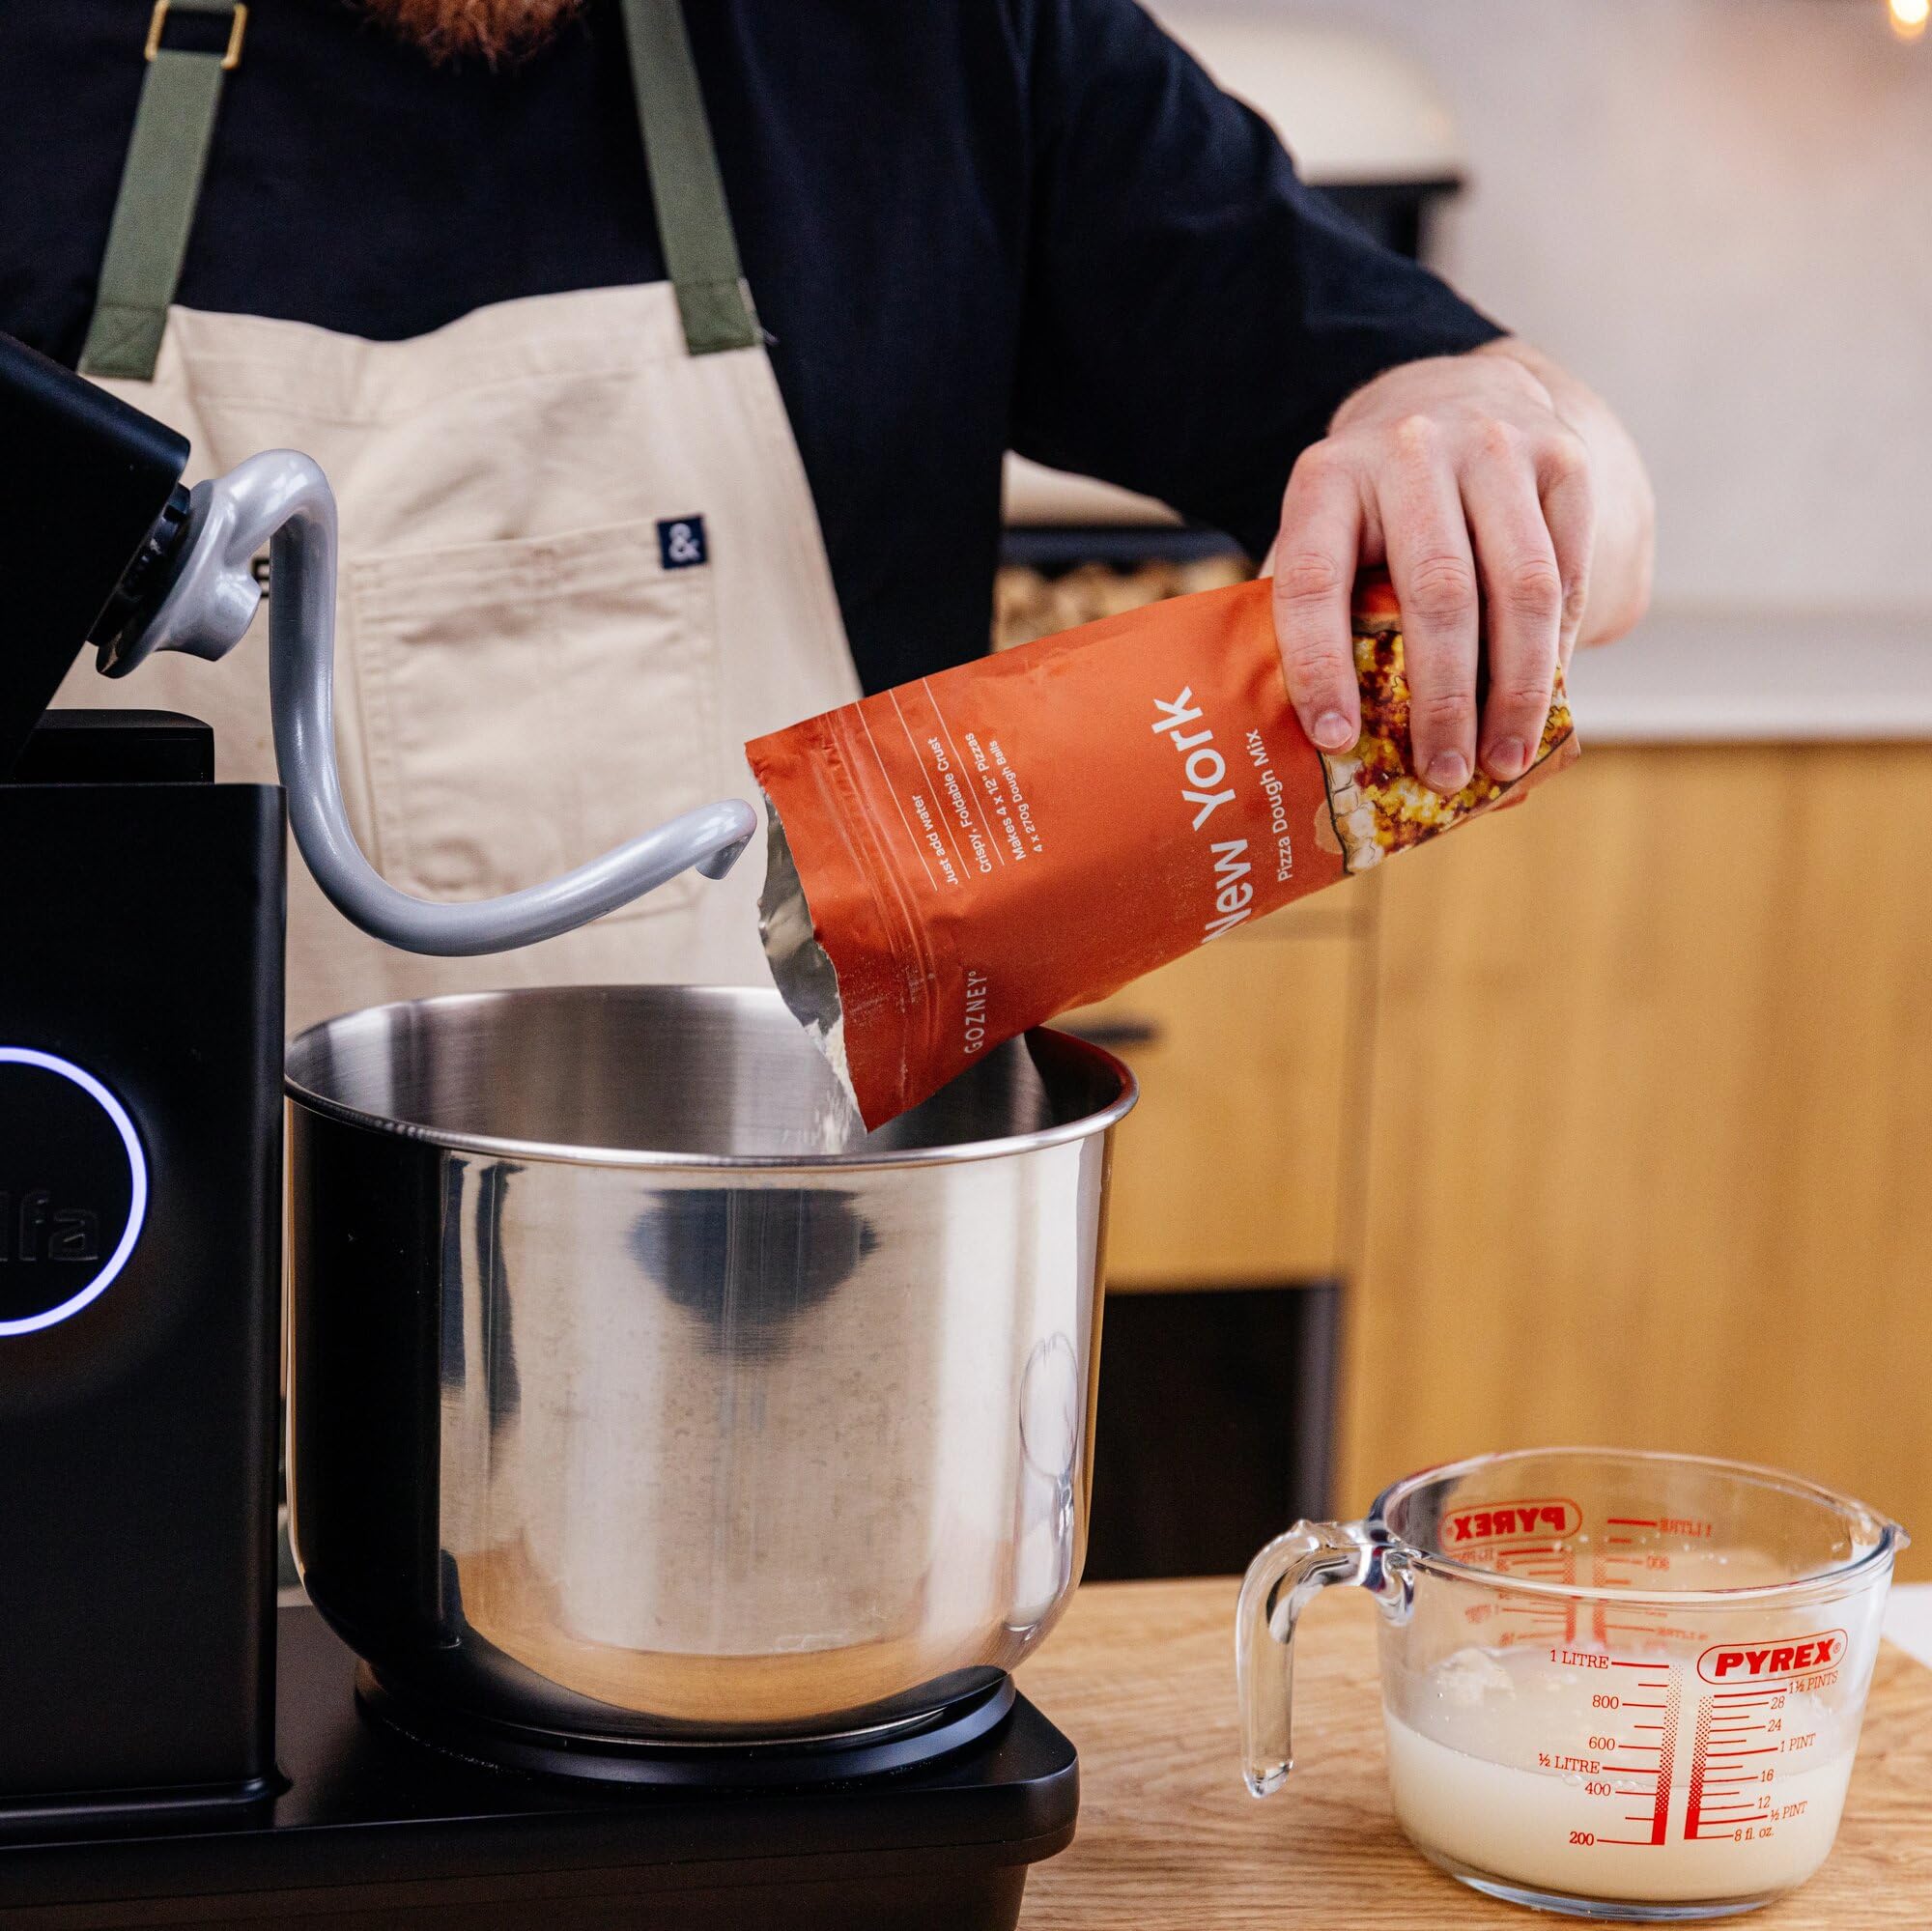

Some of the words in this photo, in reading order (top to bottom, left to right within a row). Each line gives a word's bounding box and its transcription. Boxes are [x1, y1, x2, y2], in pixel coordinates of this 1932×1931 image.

[927, 736, 950, 772] Crust
[965, 732, 990, 773] Pizzas
[989, 740, 1007, 766] Balls
[1246, 729, 1269, 767] Mix
[1151, 686, 1236, 831] York
[1002, 766, 1023, 803] Dough
[944, 772, 973, 829] Foldable
[994, 795, 1005, 805] x
[1260, 769, 1288, 834] Dough
[912, 794, 933, 831] water
[996, 807, 1007, 816] 4
[1018, 803, 1036, 834] 270g
[925, 832, 946, 857] add
[1003, 817, 1027, 861] Makes
[1033, 844, 1042, 853] 4
[1277, 836, 1293, 882] Pizza
[939, 859, 959, 886] Just
[1201, 838, 1253, 944] New
[1550, 1649, 1556, 1661] 1
[1562, 1650, 1609, 1669] LITRE
[1806, 1670, 1839, 1691] PINTS
[1592, 1694, 1619, 1710] 800
[1771, 1695, 1786, 1710] 28
[1767, 1718, 1781, 1732] 24
[1589, 1736, 1615, 1750] 600
[1789, 1733, 1816, 1750] PINT
[1554, 1755, 1601, 1774] LITRE
[1761, 1769, 1775, 1782] 16
[1585, 1782, 1611, 1797] 400
[1758, 1796, 1771, 1809] 12
[1782, 1801, 1807, 1819] PINT
[1569, 1831, 1595, 1846] 200
[1734, 1829, 1742, 1842] 8
